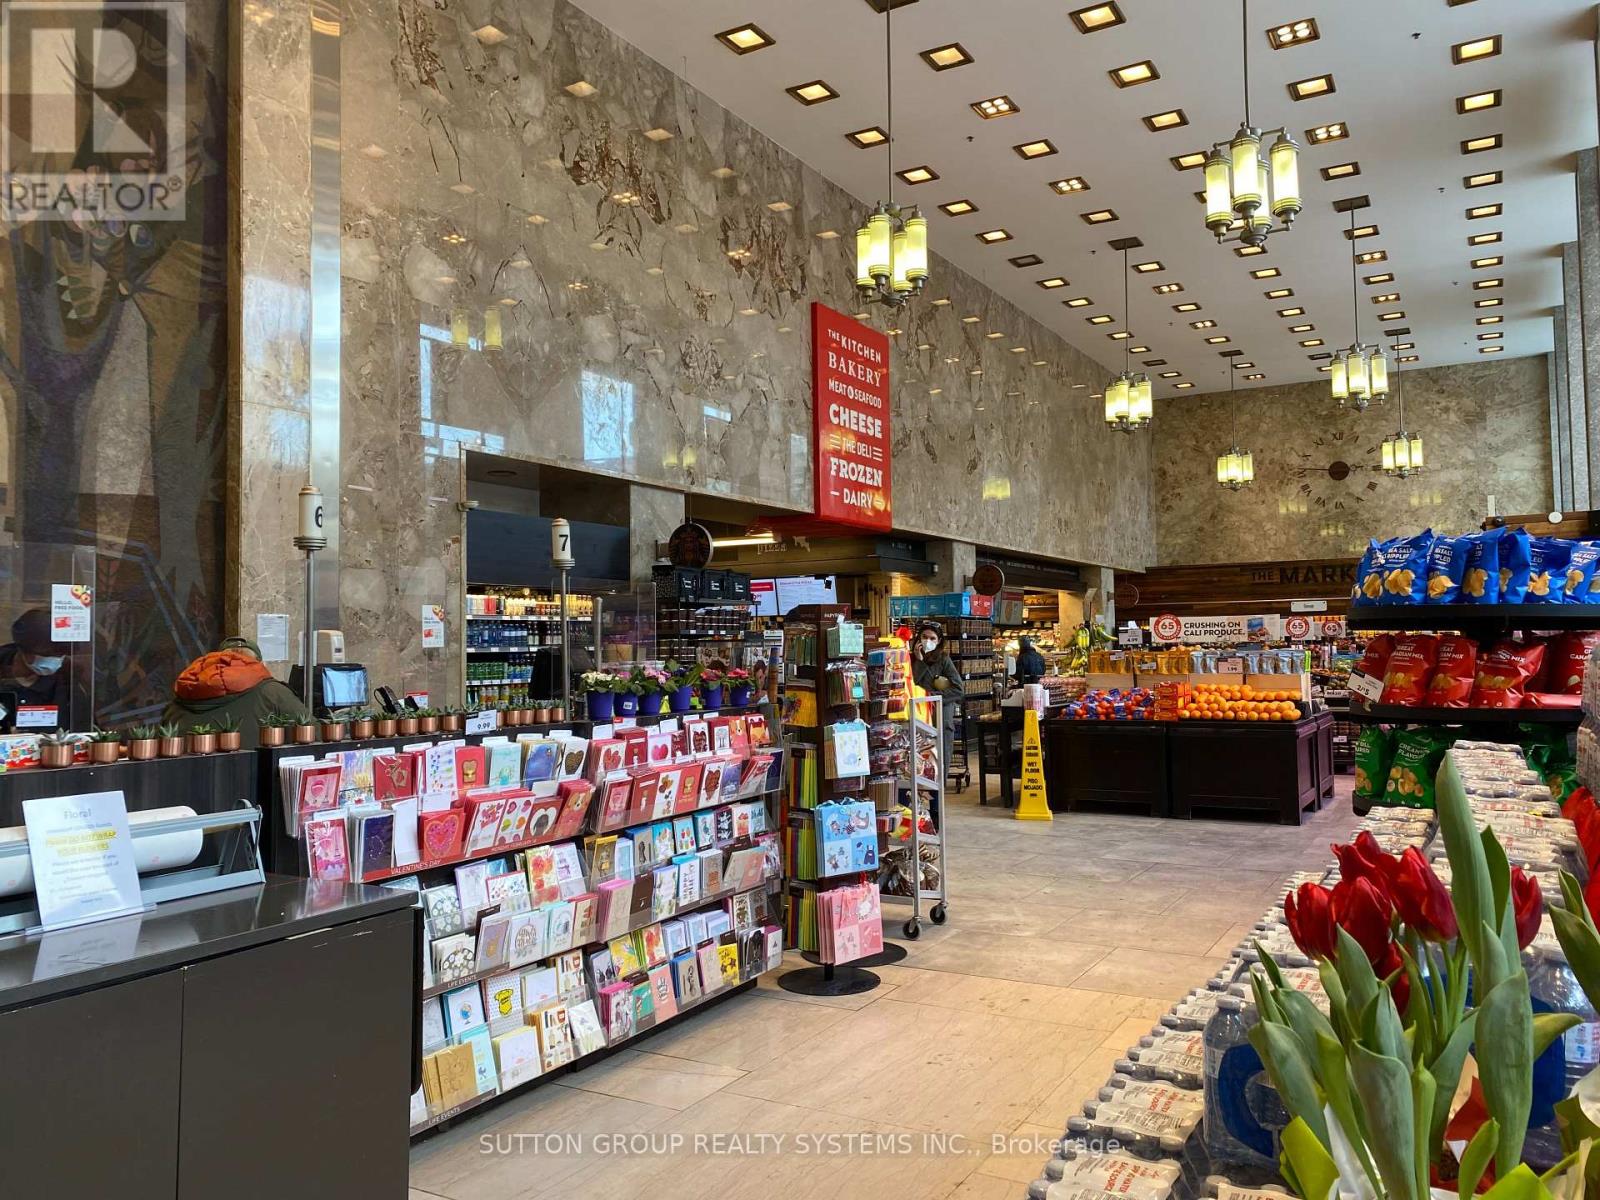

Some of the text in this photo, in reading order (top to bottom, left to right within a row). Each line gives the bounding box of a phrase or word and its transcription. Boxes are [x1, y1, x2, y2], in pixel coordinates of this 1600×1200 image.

[828, 329, 882, 364] THE KITCHEN
[828, 351, 881, 387] BAKERY
[828, 378, 847, 396] MEAT
[854, 389, 882, 409] SEAFOOD
[829, 403, 882, 439] CHEESE
[842, 438, 872, 458] THE DELI
[830, 456, 883, 487] FROZEN
[843, 487, 873, 508] DAIRY
[315, 505, 323, 528] 6
[559, 534, 569, 552] 7
[1251, 568, 1274, 581] THE
[1160, 621, 1175, 630] 65
[1183, 620, 1241, 630] CRUSHING ON
[1183, 628, 1246, 637] CALI PRODUCE.
[1291, 621, 1304, 630] 65
[1326, 624, 1337, 633] 65
[477, 721, 491, 730] 9.99
[391, 860, 441, 875] VALENTINE'S DAY
[447, 974, 477, 988] LIFE EVENTS
[428, 1106, 460, 1125] LIFE EVENTS
